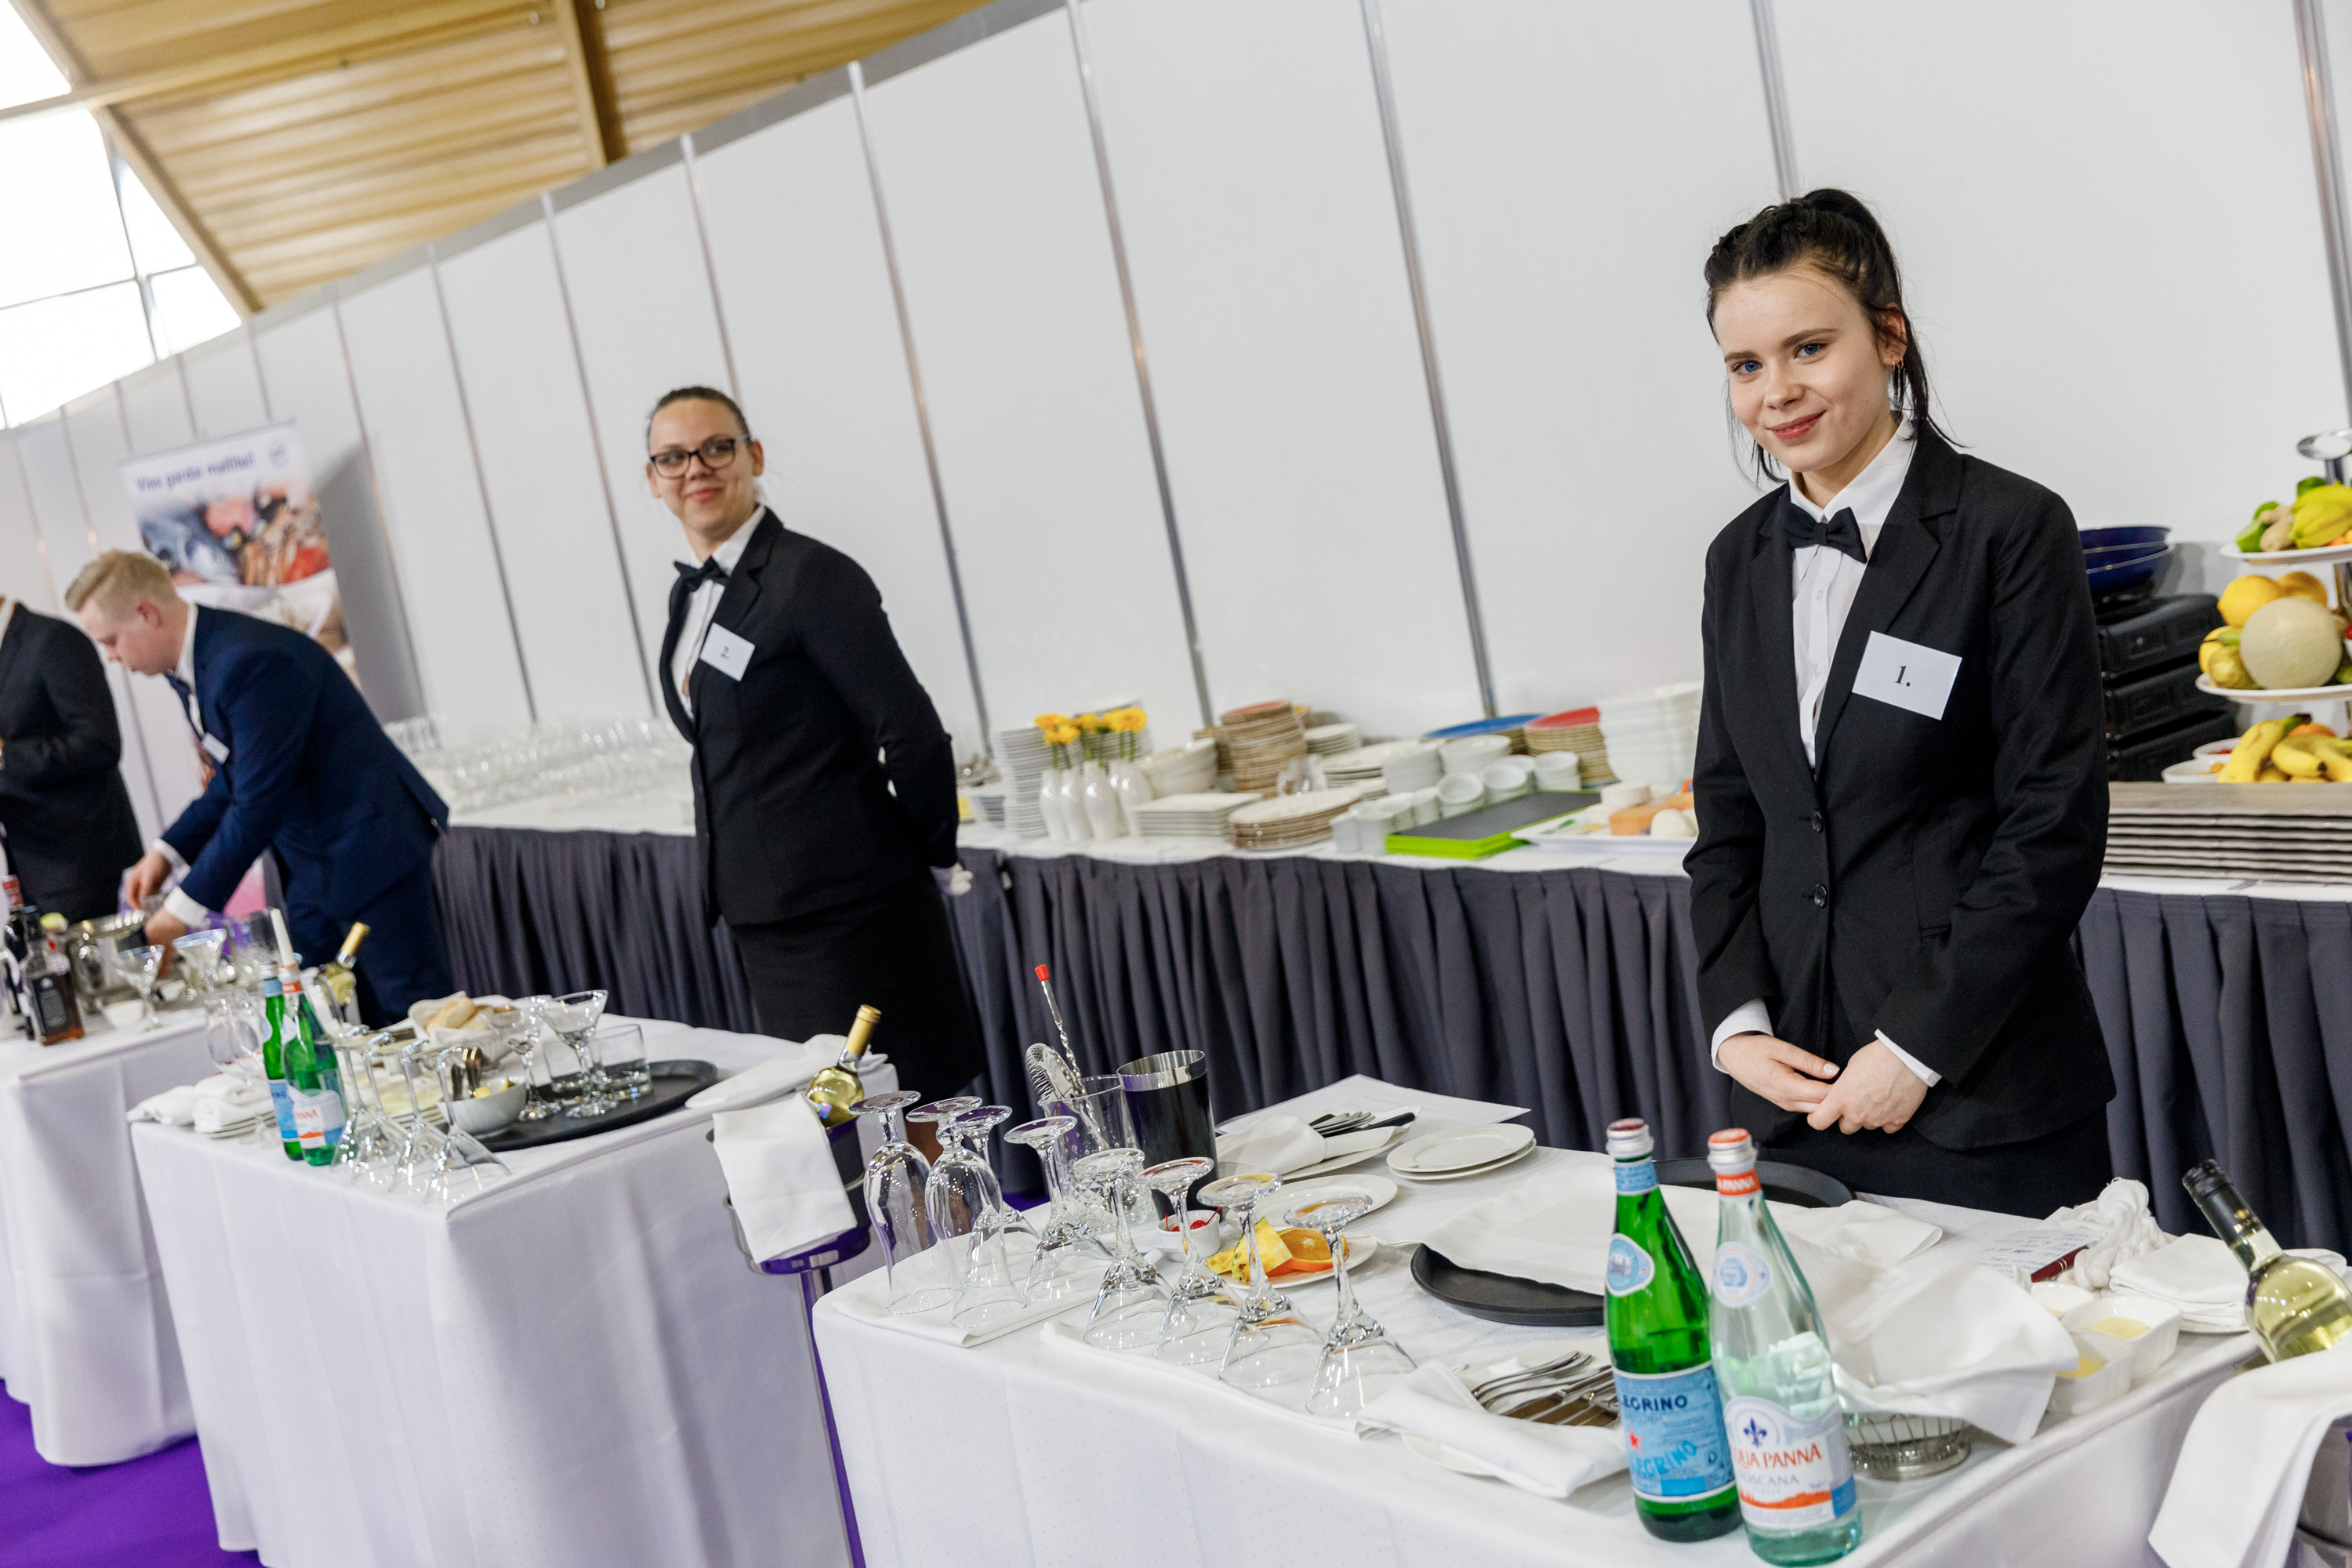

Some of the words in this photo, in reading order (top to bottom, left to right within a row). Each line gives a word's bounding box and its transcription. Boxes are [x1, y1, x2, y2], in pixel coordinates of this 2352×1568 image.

[1894, 666, 1911, 687] 1.
[1622, 1394, 1688, 1411] EGRINO
[1635, 1440, 1697, 1479] EGRINO
[1762, 1442, 1822, 1468] PANNA
